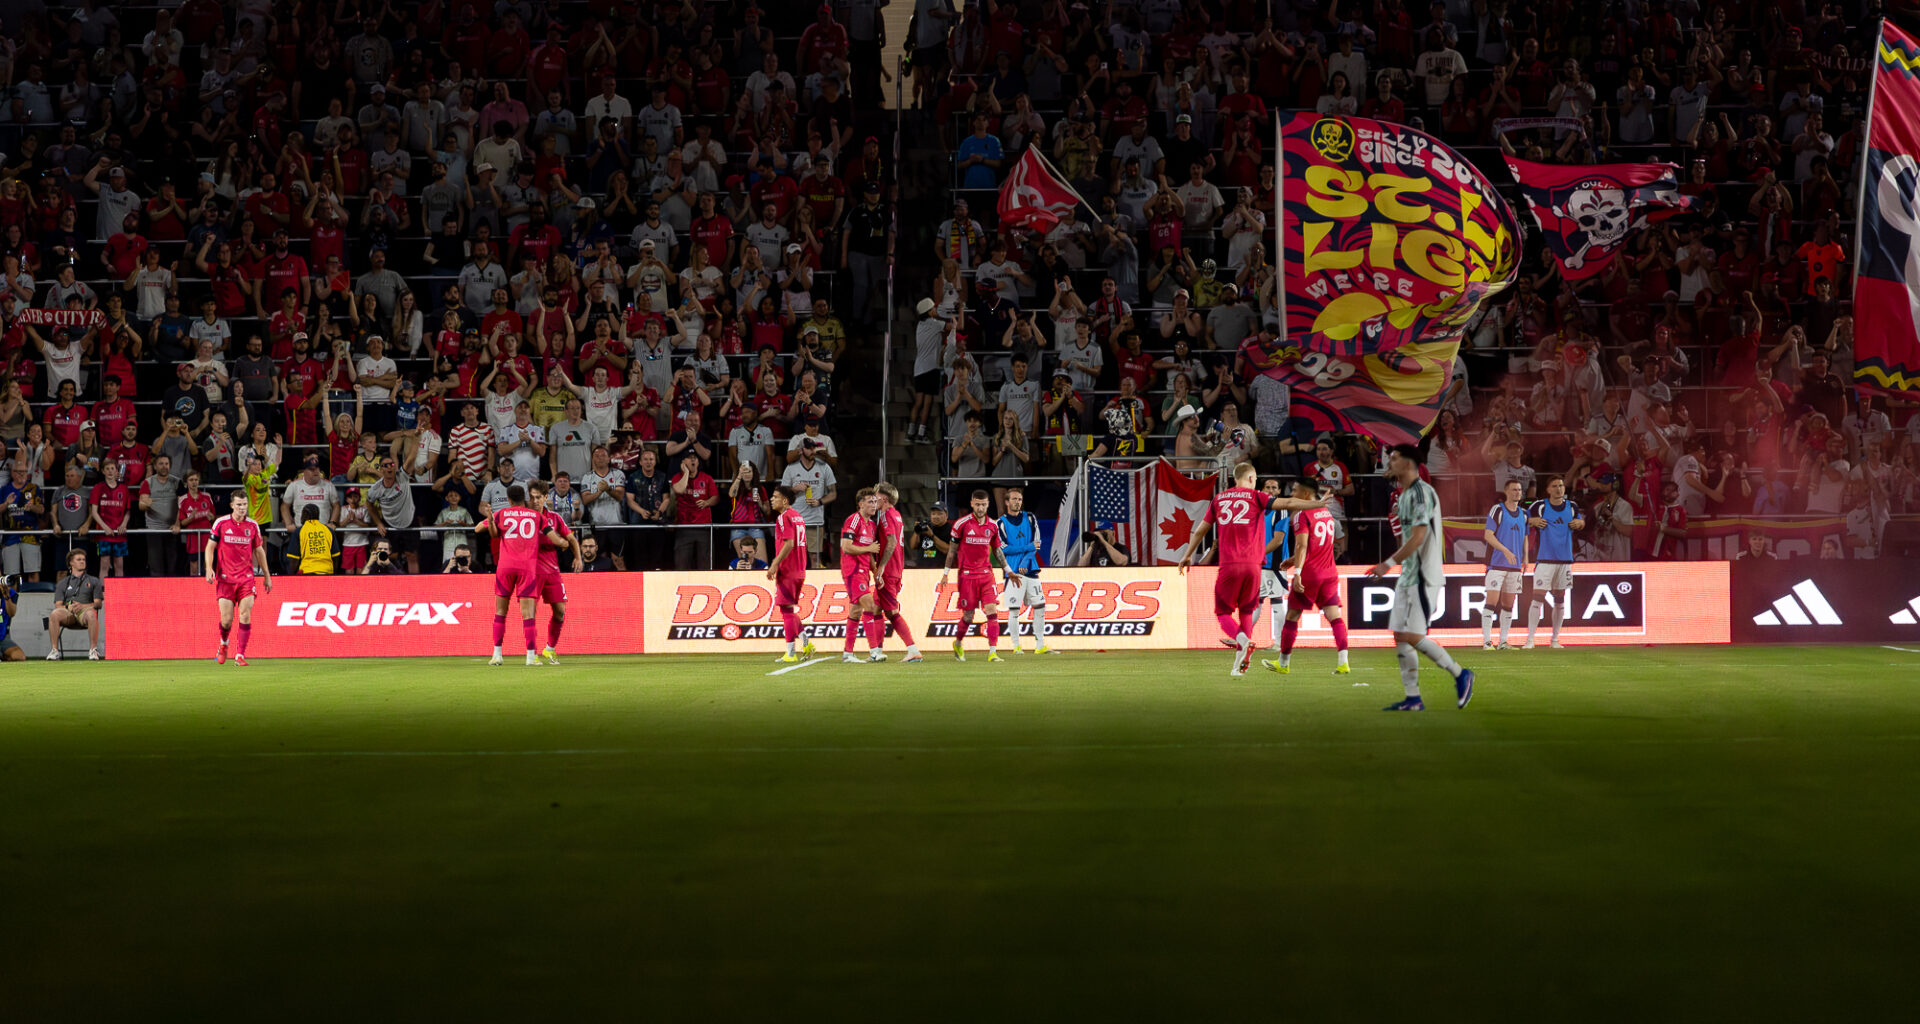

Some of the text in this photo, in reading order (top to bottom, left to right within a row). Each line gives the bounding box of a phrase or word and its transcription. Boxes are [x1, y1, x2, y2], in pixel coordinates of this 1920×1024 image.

[1357, 128, 1428, 155] SILLY
[1359, 141, 1426, 168] SINCE
[55, 310, 89, 325] CITY
[1218, 500, 1250, 525] 32
[503, 518, 536, 539] 20
[796, 524, 805, 547] 12
[1314, 520, 1335, 546] 99
[930, 580, 1163, 621] DBBS
[277, 602, 464, 633] EQUIFAX
[1061, 622, 1147, 636] CENTERS
[676, 626, 717, 638] TIRE
[723, 626, 739, 638] &
[744, 626, 787, 638] AUT
